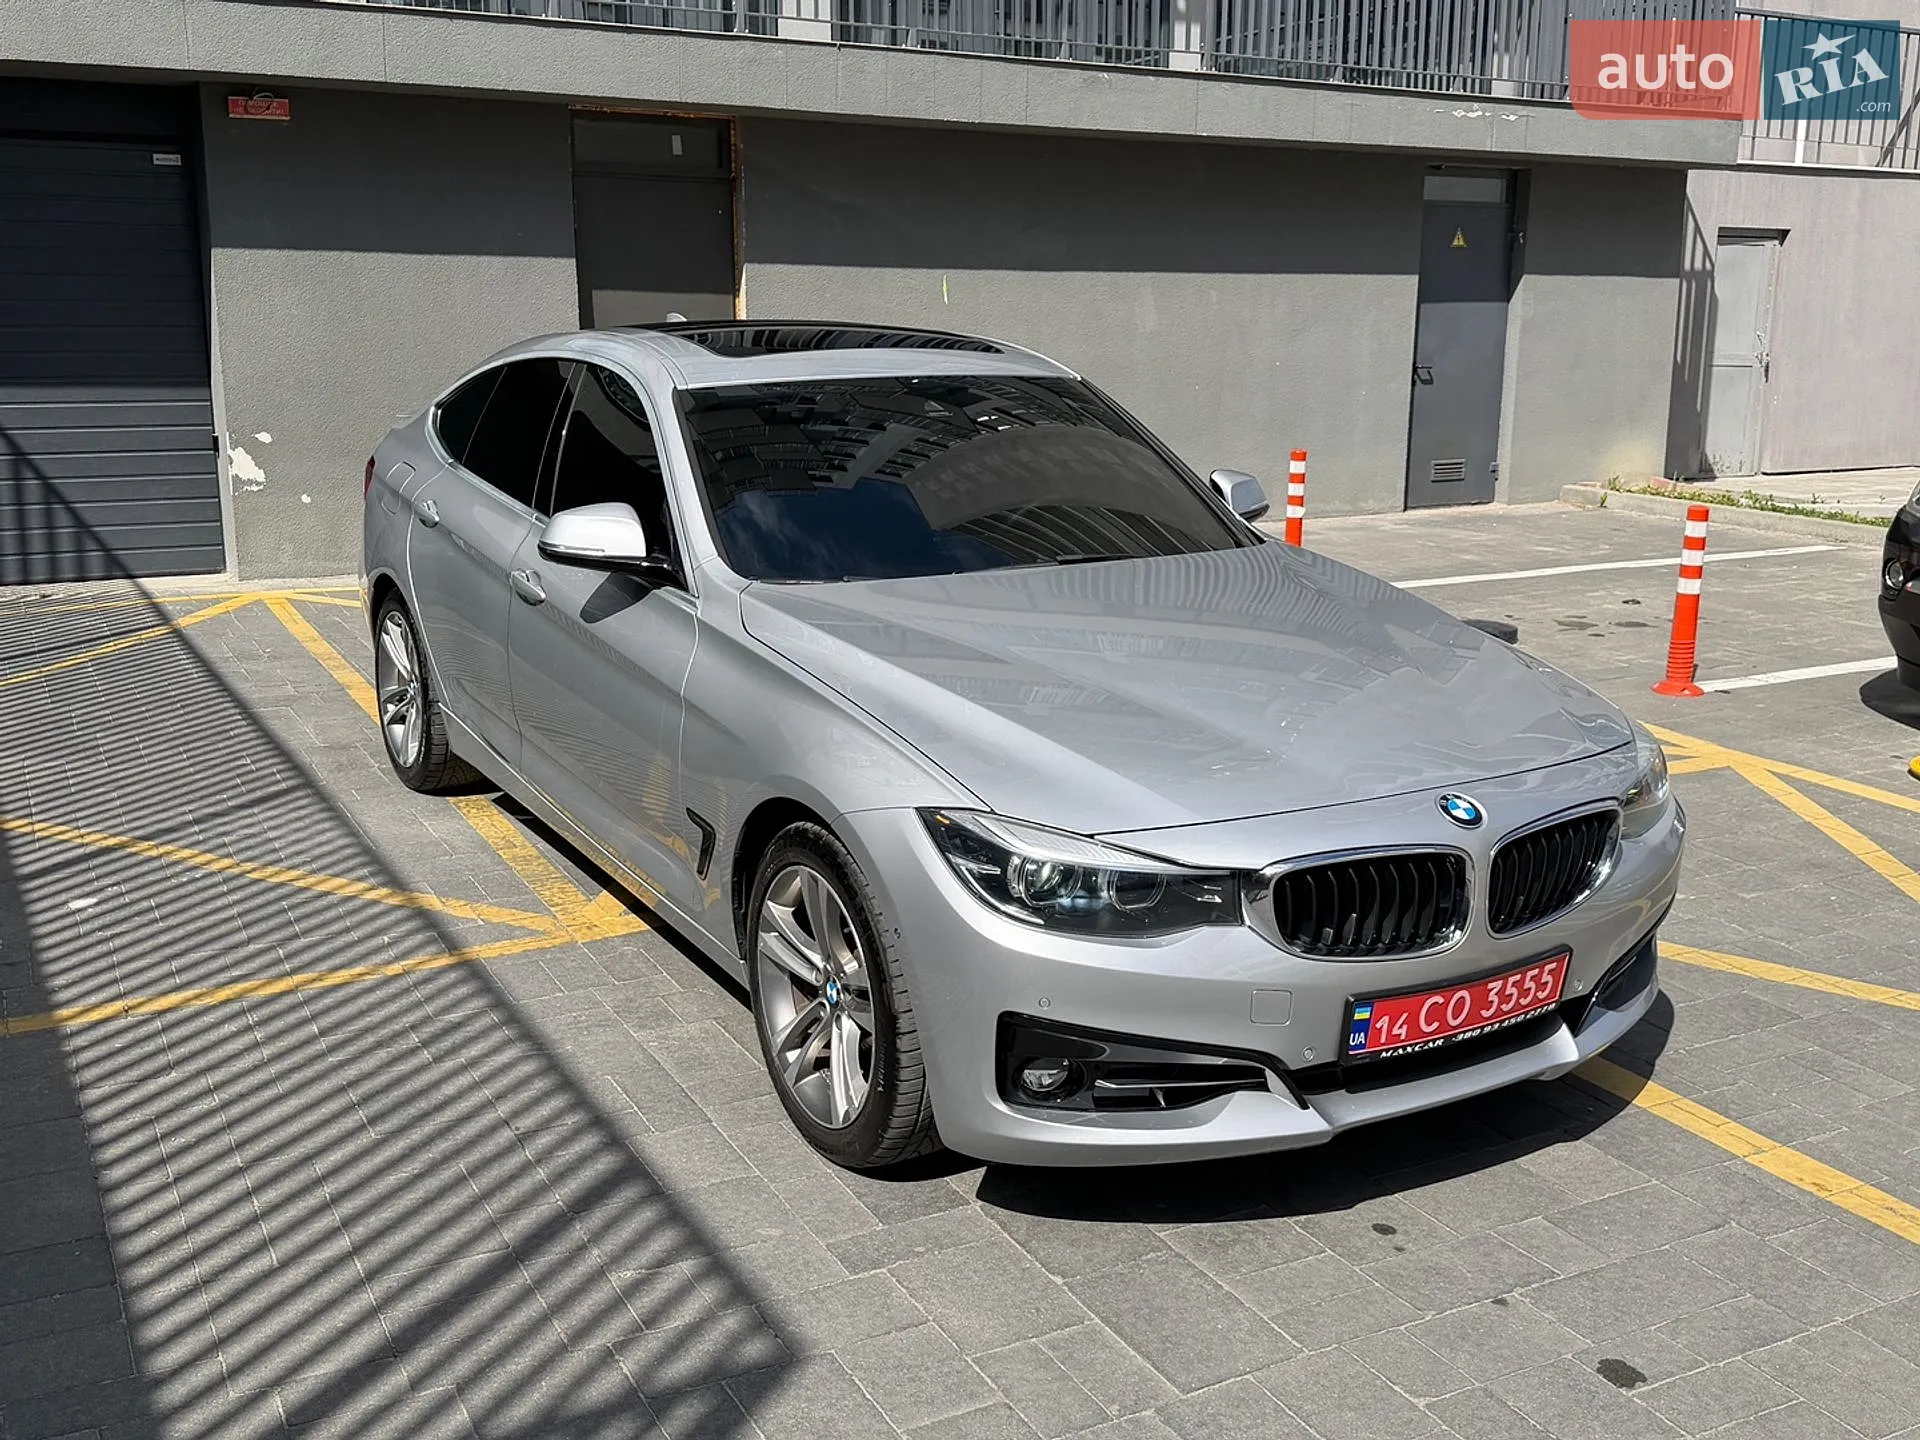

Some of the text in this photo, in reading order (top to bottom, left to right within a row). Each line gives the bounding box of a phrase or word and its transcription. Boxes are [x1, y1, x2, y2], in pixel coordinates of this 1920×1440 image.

[1374, 961, 1558, 1045] 14 CO 3555
[1349, 1032, 1366, 1046] UA
[1379, 1037, 1445, 1059] MAXCAR
